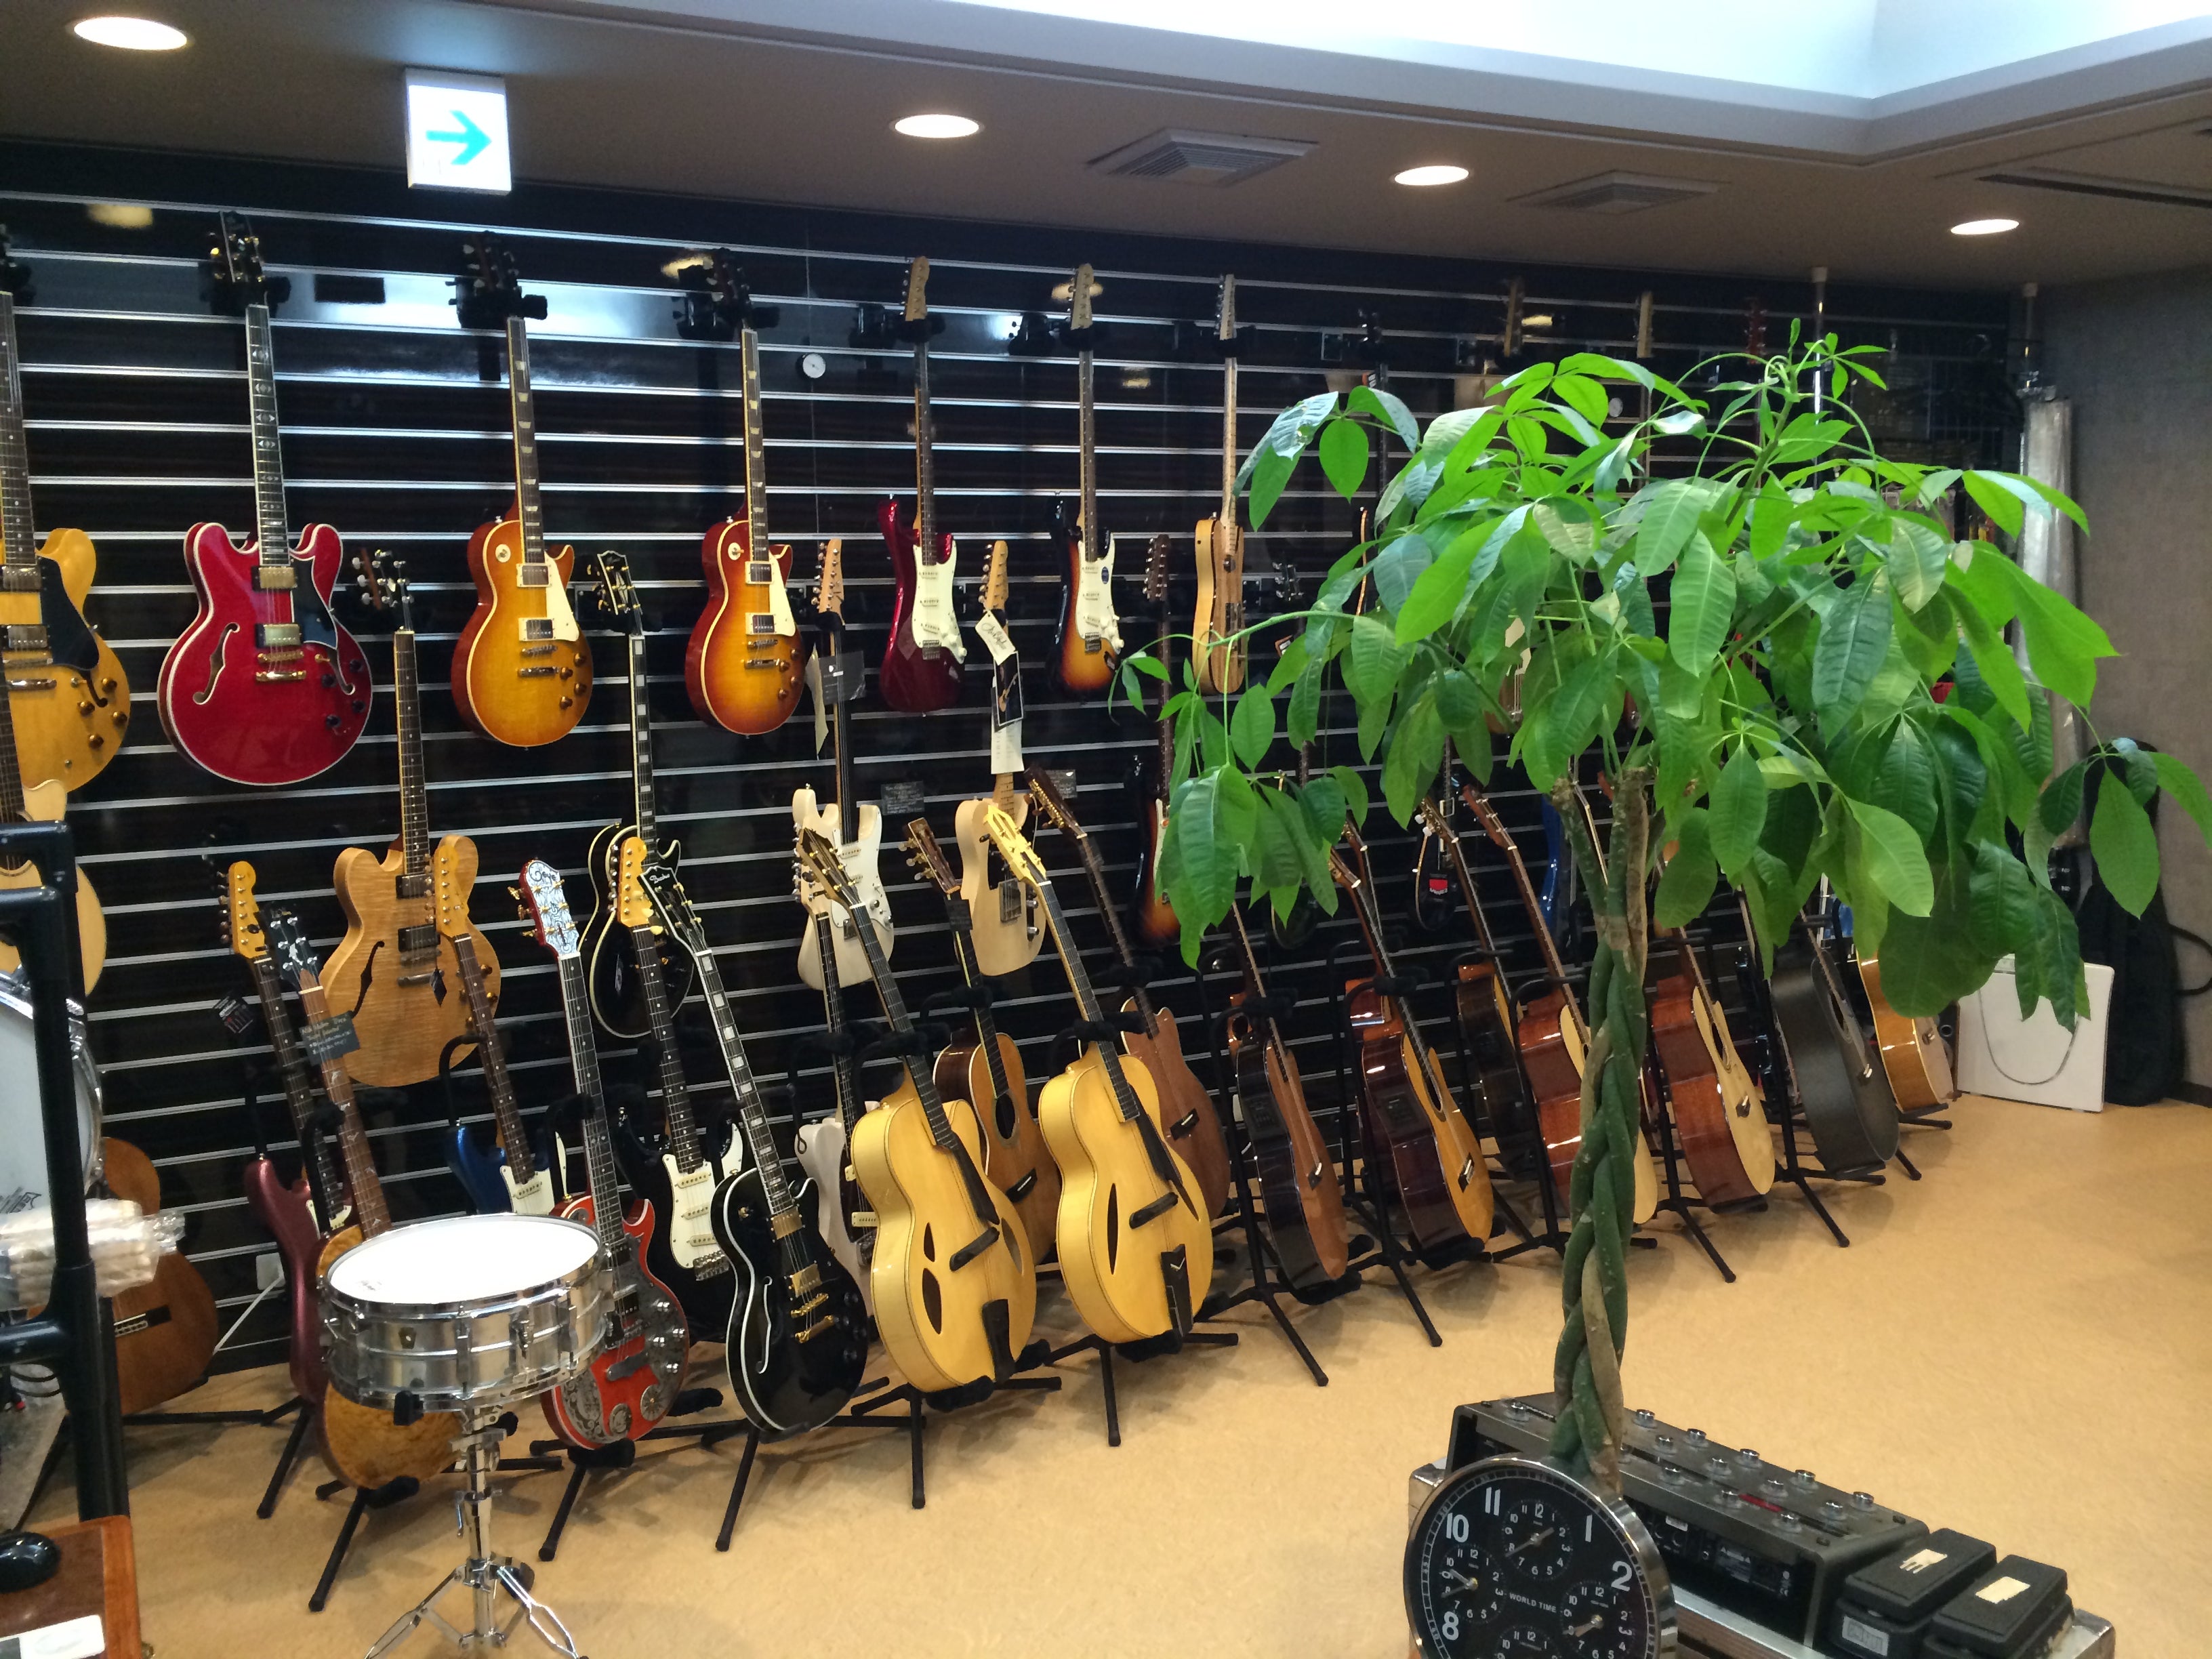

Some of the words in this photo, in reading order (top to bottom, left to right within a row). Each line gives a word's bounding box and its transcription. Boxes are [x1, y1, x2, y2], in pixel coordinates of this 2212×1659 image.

[1485, 1487, 1500, 1516] 11
[1522, 1504, 1528, 1514] 11
[1535, 1503, 1544, 1518] 12
[1510, 1513, 1519, 1523] 10
[1446, 1513, 1469, 1542] 10
[1504, 1527, 1513, 1535] 9
[1559, 1527, 1566, 1537] 2
[1585, 1514, 1593, 1542] 1
[1561, 1544, 1571, 1552] 3
[1458, 1549, 1463, 1558] 11
[1470, 1549, 1479, 1559] 12
[1446, 1557, 1454, 1567] 10
[1519, 1557, 1525, 1566] 7
[1557, 1557, 1563, 1567] 4
[1532, 1565, 1538, 1575] 6
[1547, 1565, 1553, 1576] 5
[1492, 1572, 1499, 1582] 2
[1611, 1561, 1633, 1592] 2
[1495, 1588, 1504, 1596] 3
[1581, 1586, 1587, 1596] 11
[1595, 1586, 1605, 1597] 12
[1454, 1600, 1460, 1610] 7
[1509, 1592, 1537, 1607] WORLD
[1539, 1601, 1557, 1613] TIME
[1569, 1595, 1578, 1605] 10
[1491, 1601, 1497, 1611] 4
[1467, 1609, 1473, 1618] 6
[1481, 1609, 1487, 1619] 5
[1563, 1609, 1572, 1618] 9
[1620, 1610, 1628, 1621] 2
[1442, 1611, 1459, 1641] 8
[1618, 1626, 1633, 1636] 3
[1513, 1631, 1519, 1640] 11
[1527, 1631, 1536, 1641] 12
[1502, 1639, 1511, 1650] 10
[1578, 1639, 1585, 1650] 7
[1618, 1641, 1626, 1652] 4
